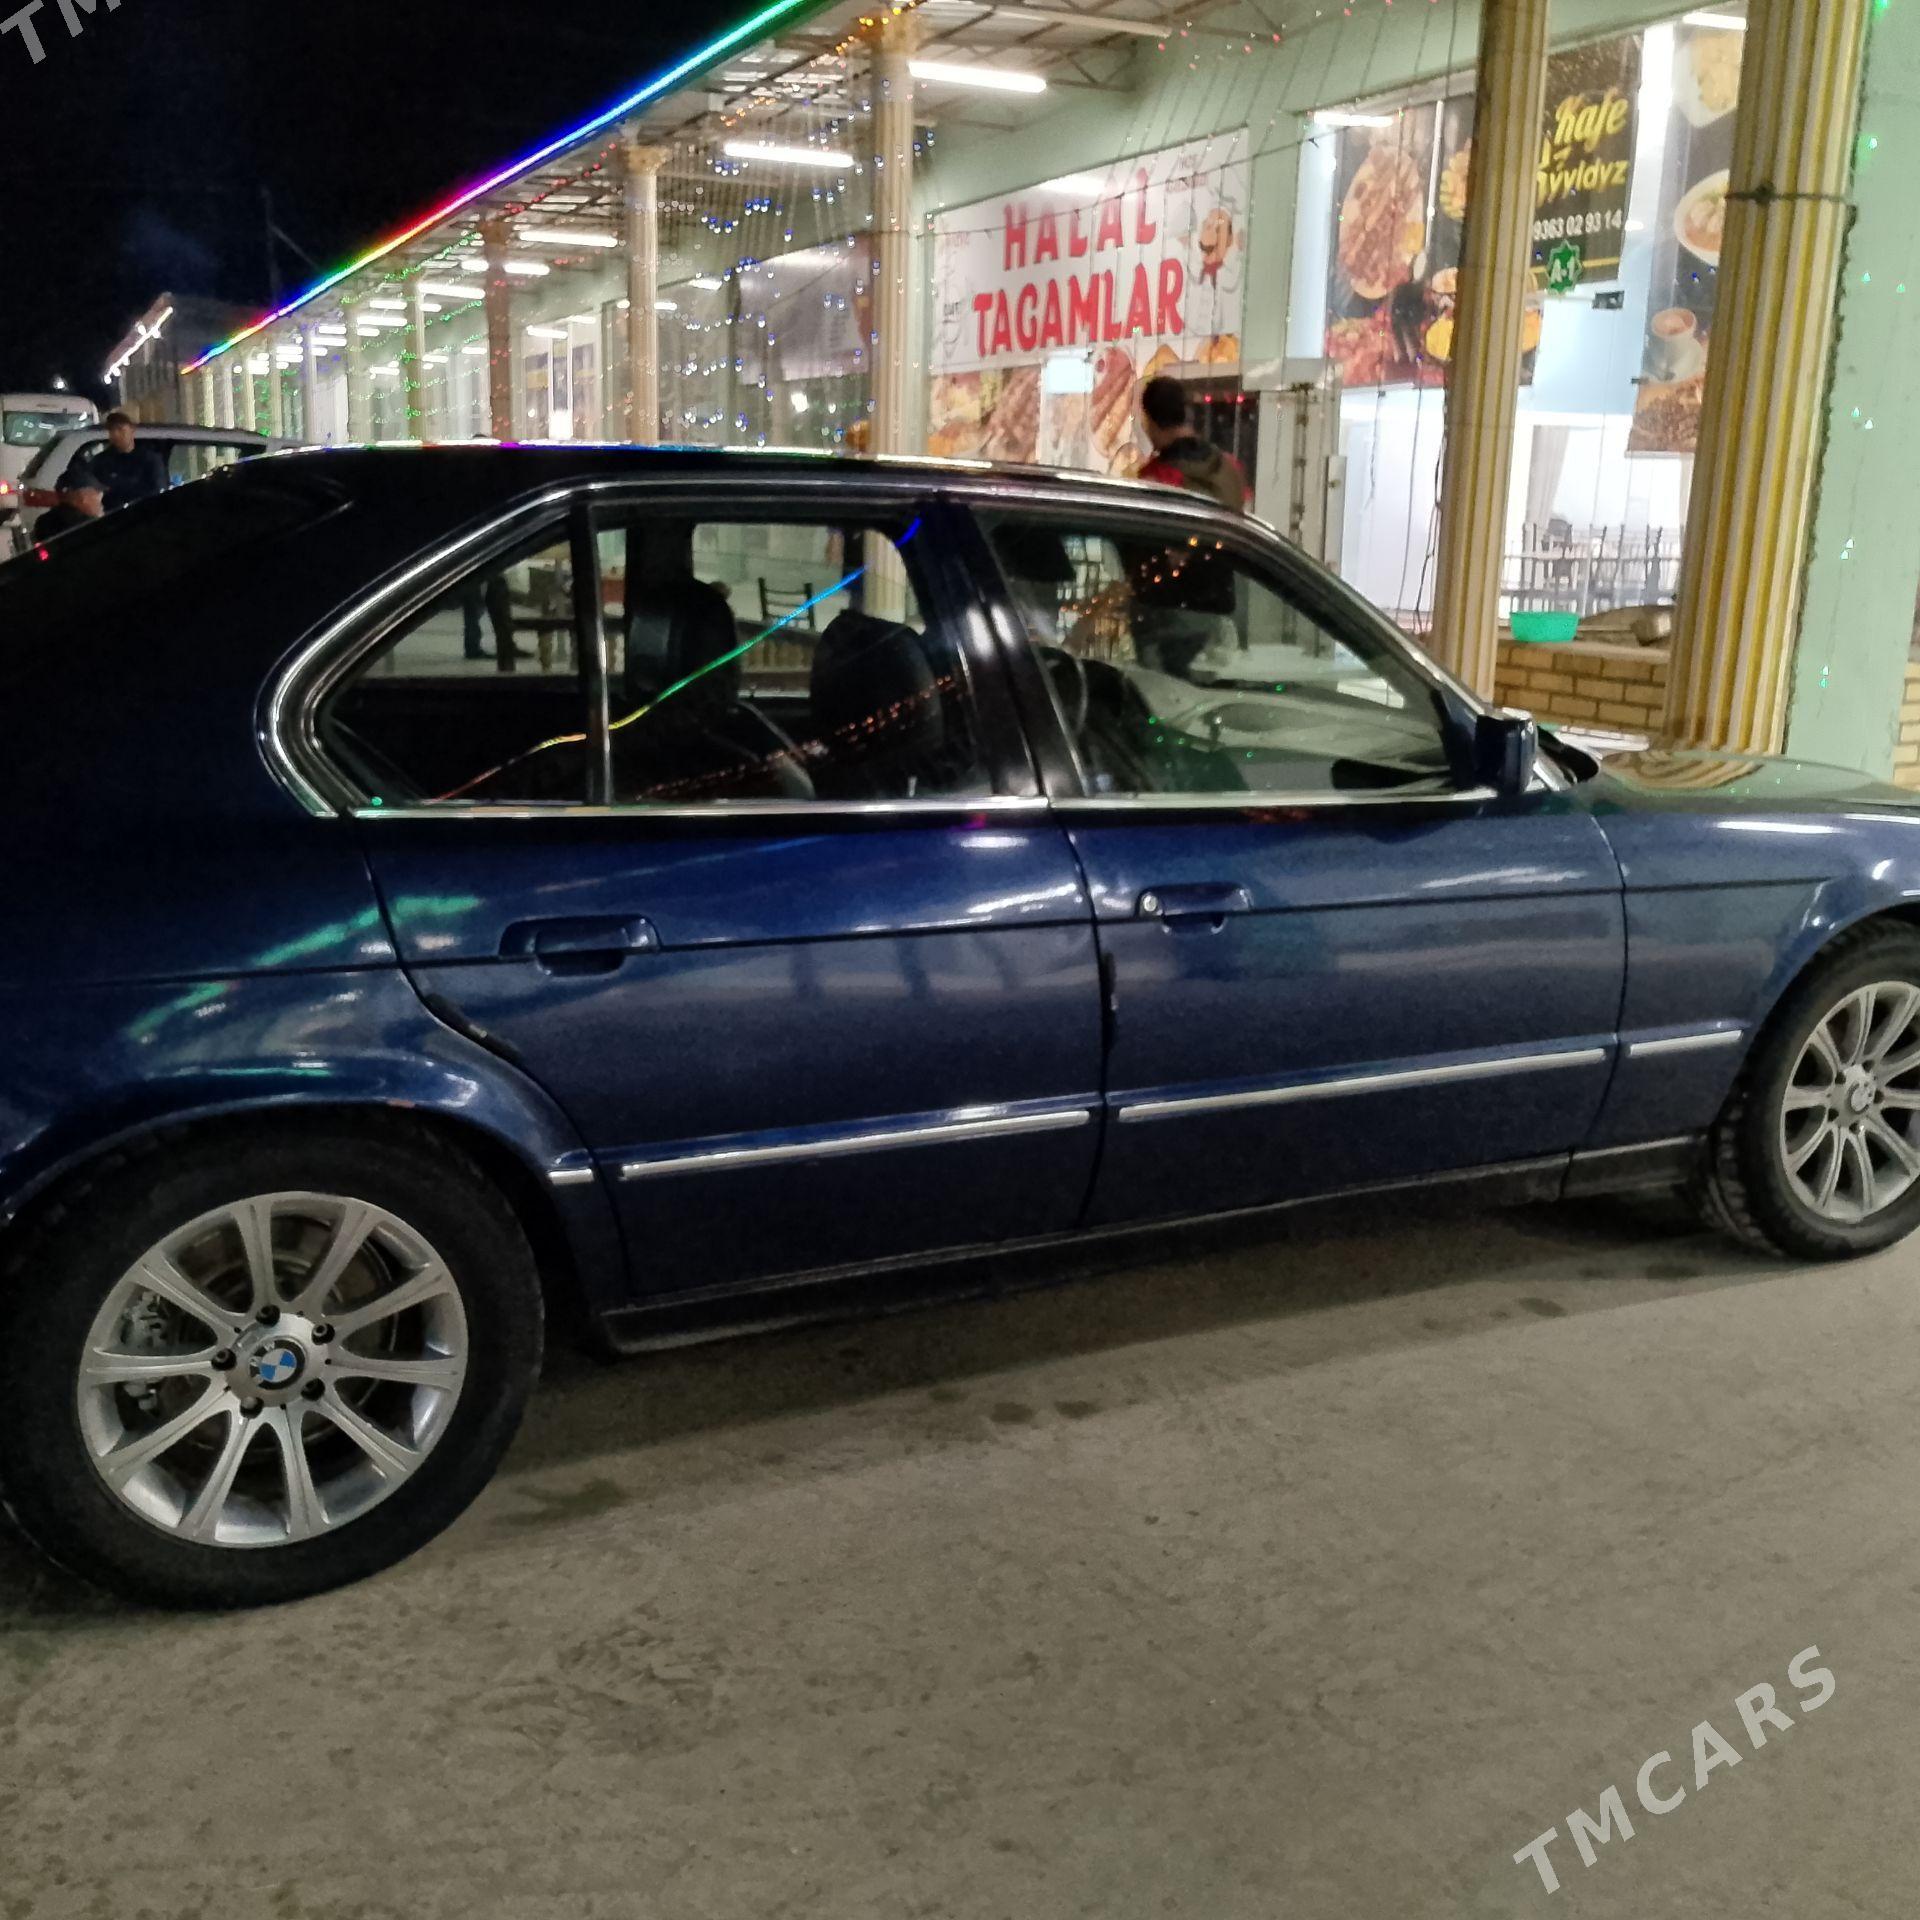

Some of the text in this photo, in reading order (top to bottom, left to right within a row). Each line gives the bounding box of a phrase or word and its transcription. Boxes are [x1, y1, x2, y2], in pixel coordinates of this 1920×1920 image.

[1003, 167, 1158, 271] HALAL
[1566, 214, 1584, 236] 02
[1605, 208, 1622, 231] 14
[972, 257, 1186, 358] TAGAMLAR
